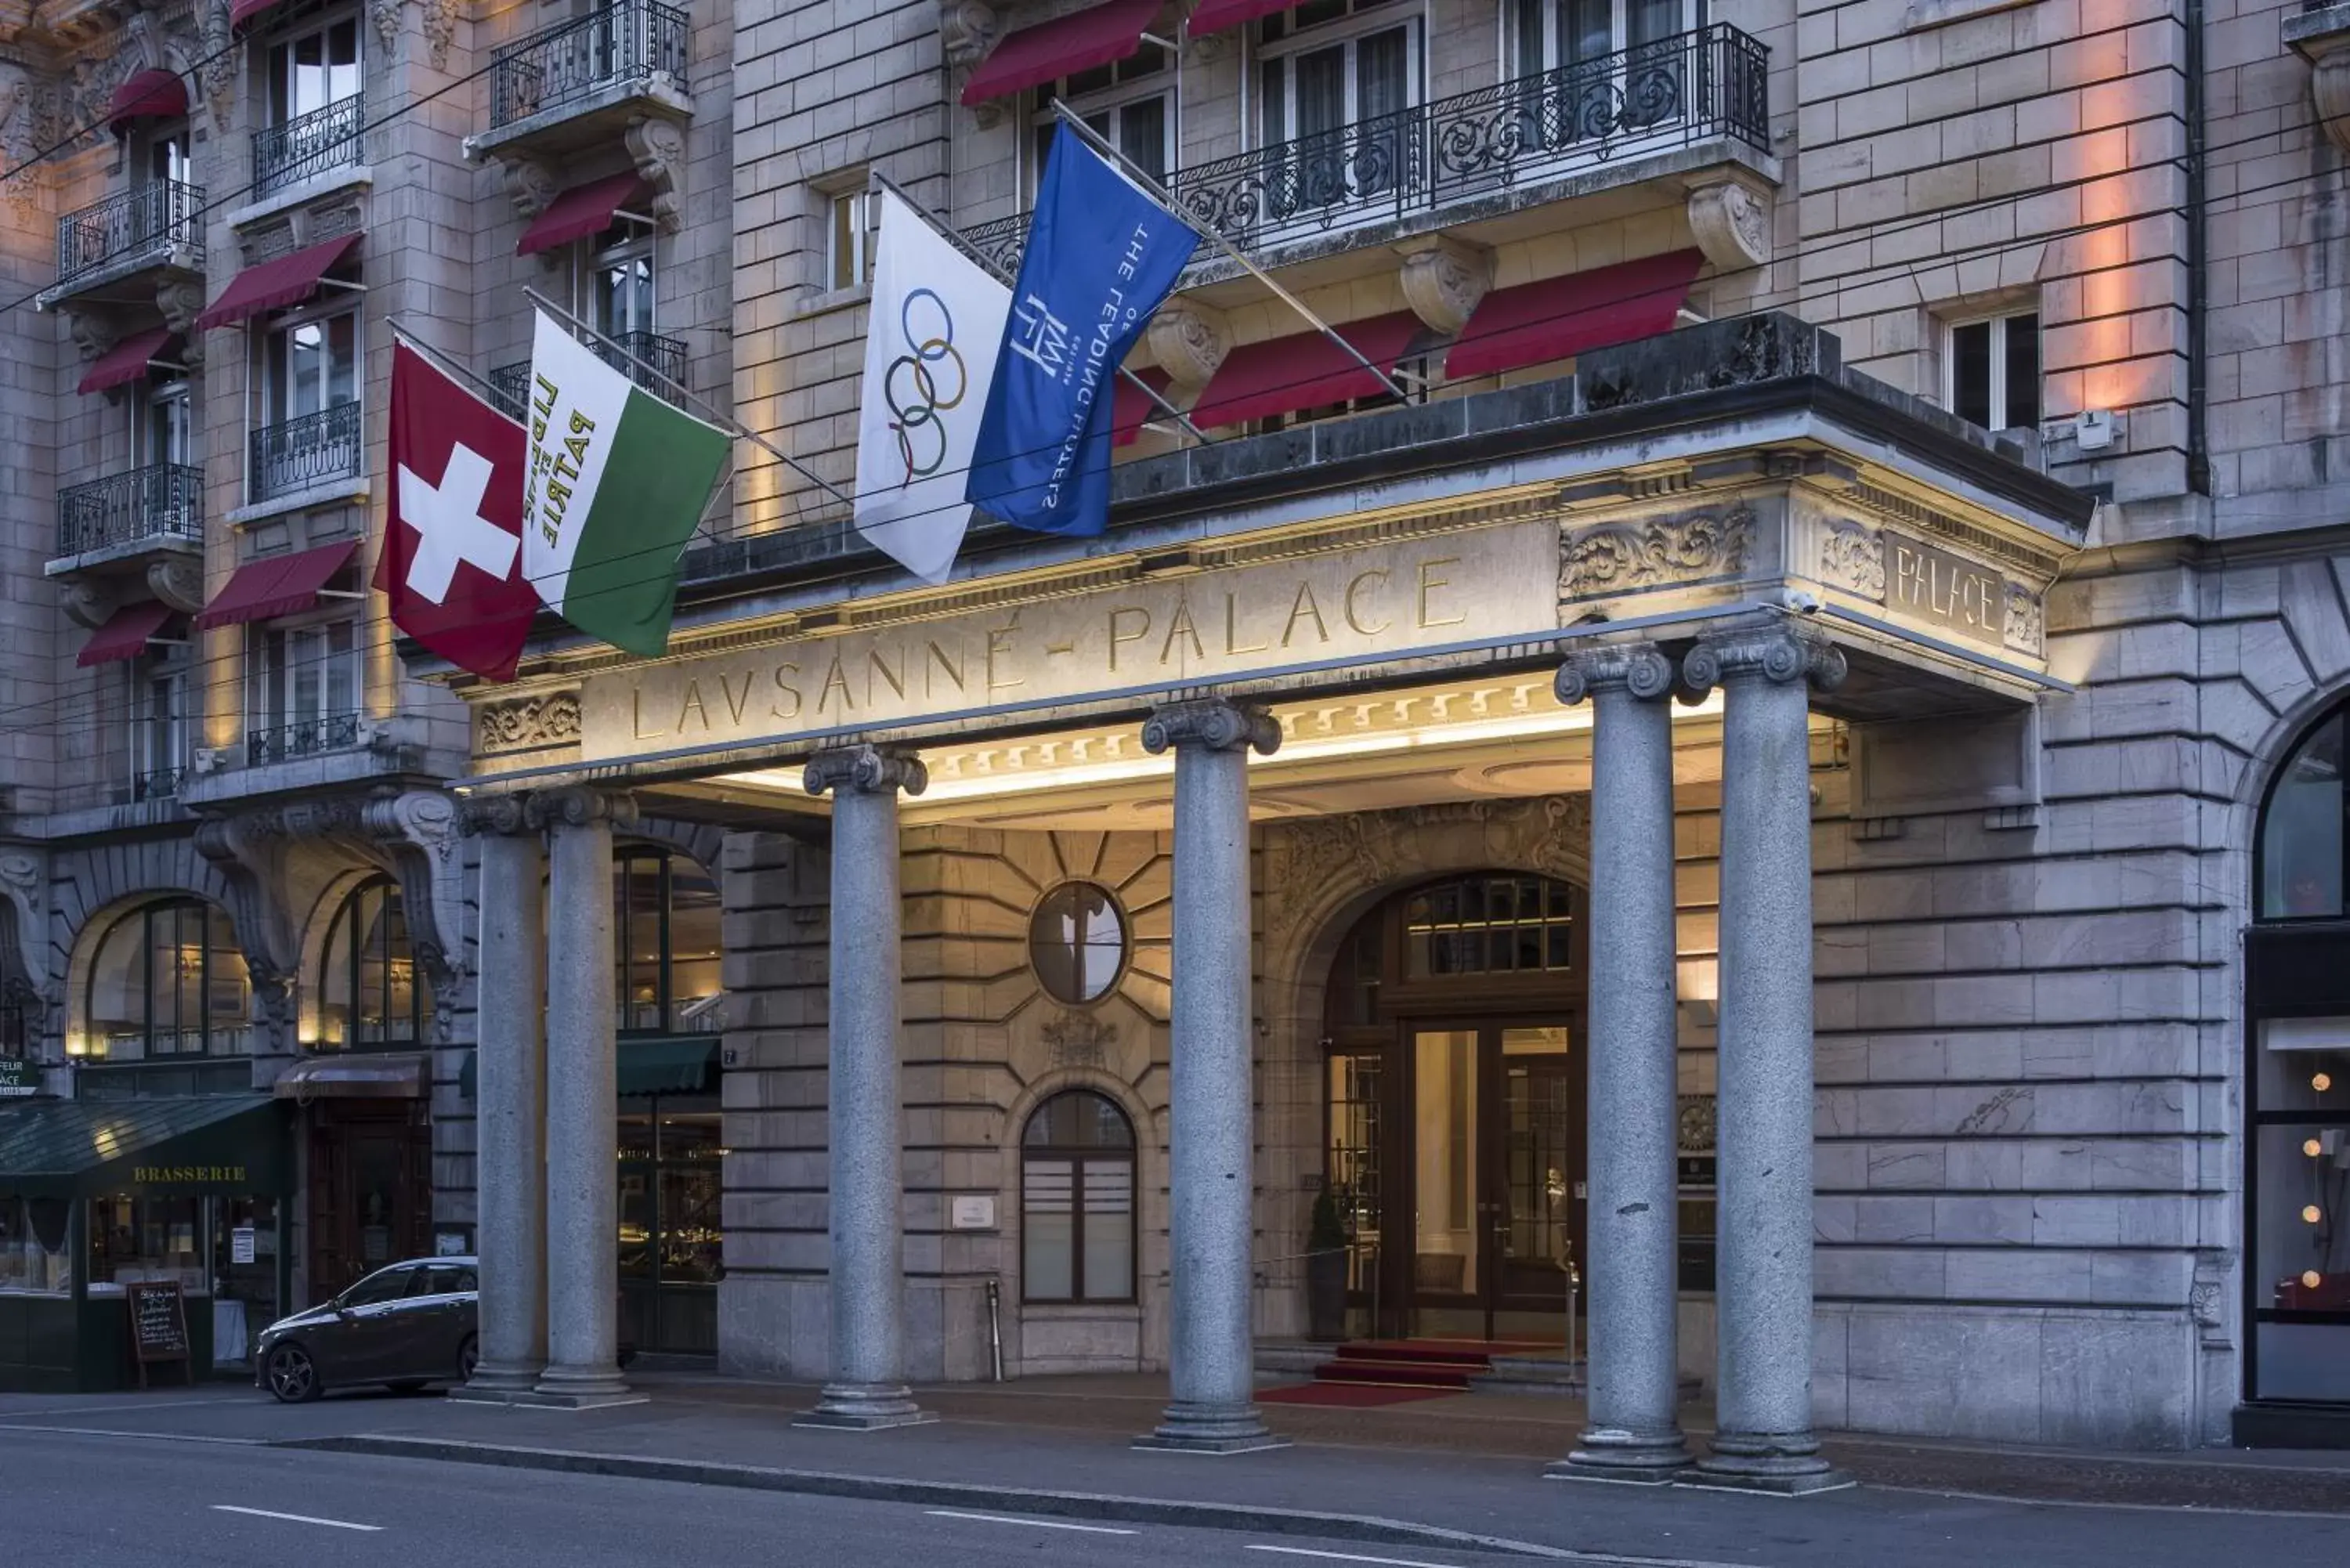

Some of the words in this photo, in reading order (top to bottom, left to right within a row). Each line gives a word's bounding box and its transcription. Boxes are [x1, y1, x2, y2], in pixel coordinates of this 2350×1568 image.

[1108, 557, 1467, 672] PALACE
[1898, 546, 1997, 631] PALACE
[133, 1166, 246, 1182] BRASSERIE
